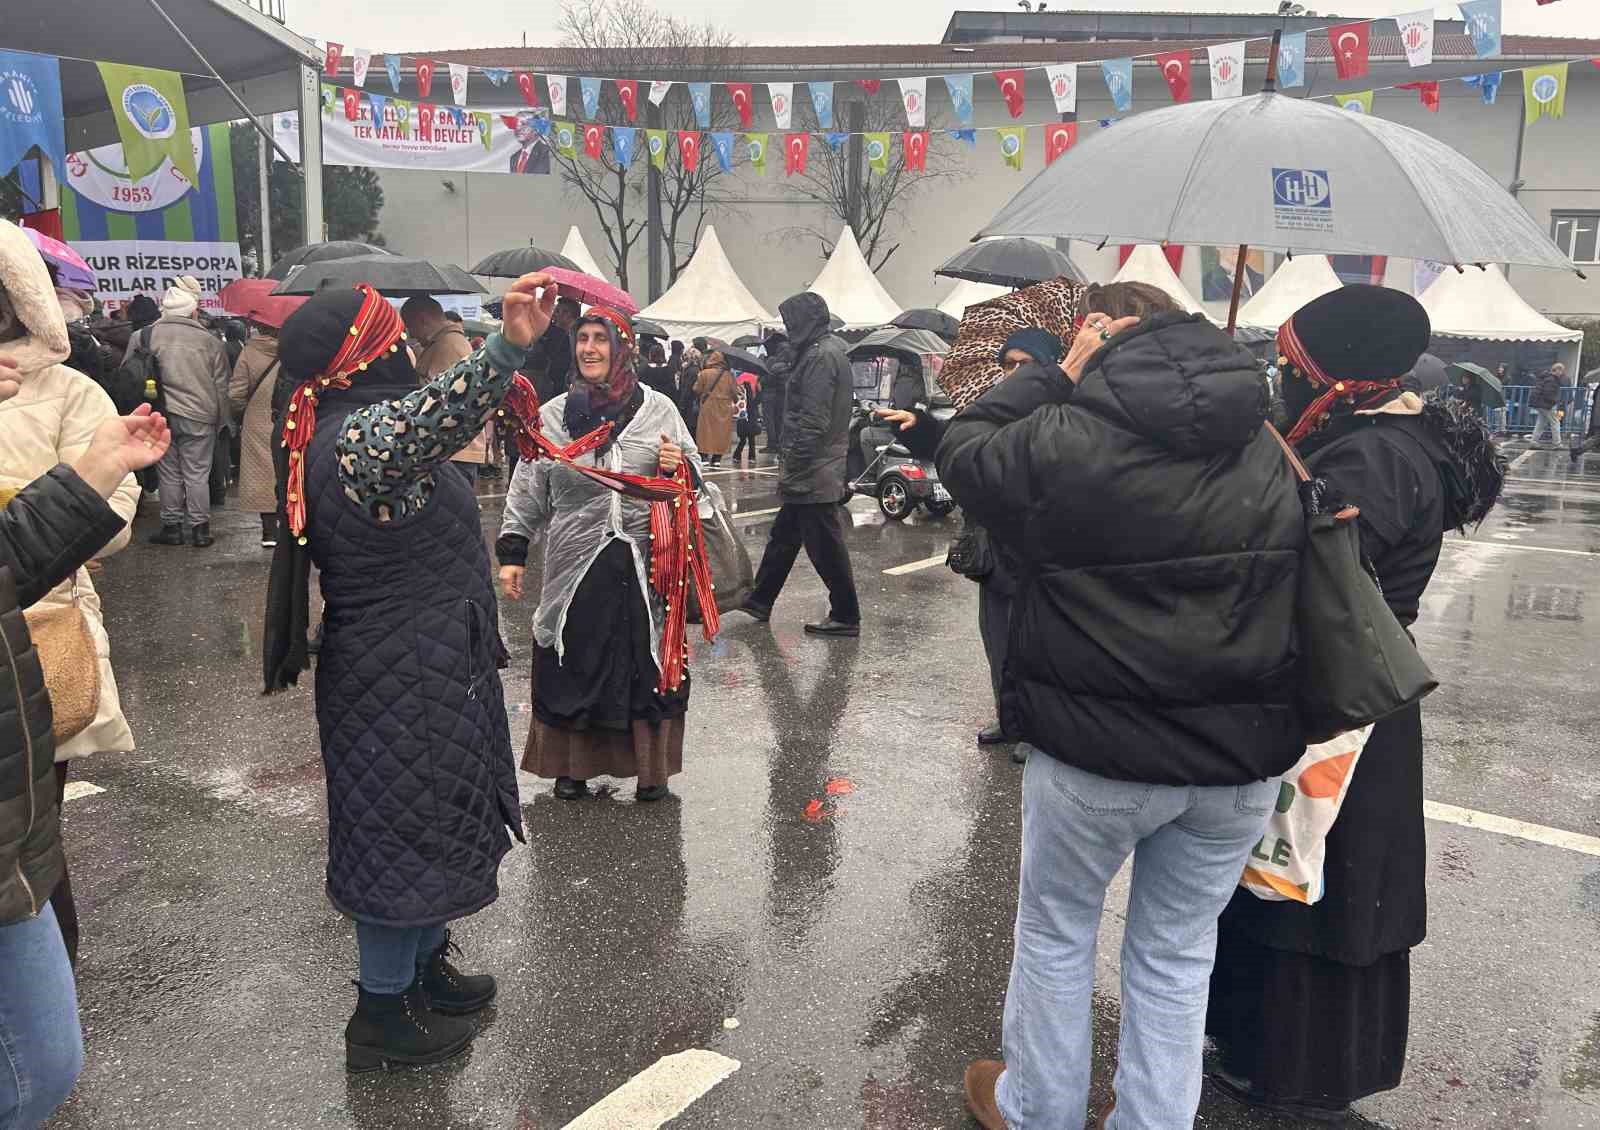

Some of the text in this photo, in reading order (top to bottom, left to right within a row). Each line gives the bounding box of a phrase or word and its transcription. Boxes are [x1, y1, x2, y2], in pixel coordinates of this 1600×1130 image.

[439, 111, 479, 126] BARA
[353, 126, 372, 139] TEK
[435, 129, 474, 144] DEVLET
[112, 186, 153, 202] 1953
[126, 252, 238, 271] RİZESPOR'A
[94, 277, 157, 292] RILAR
